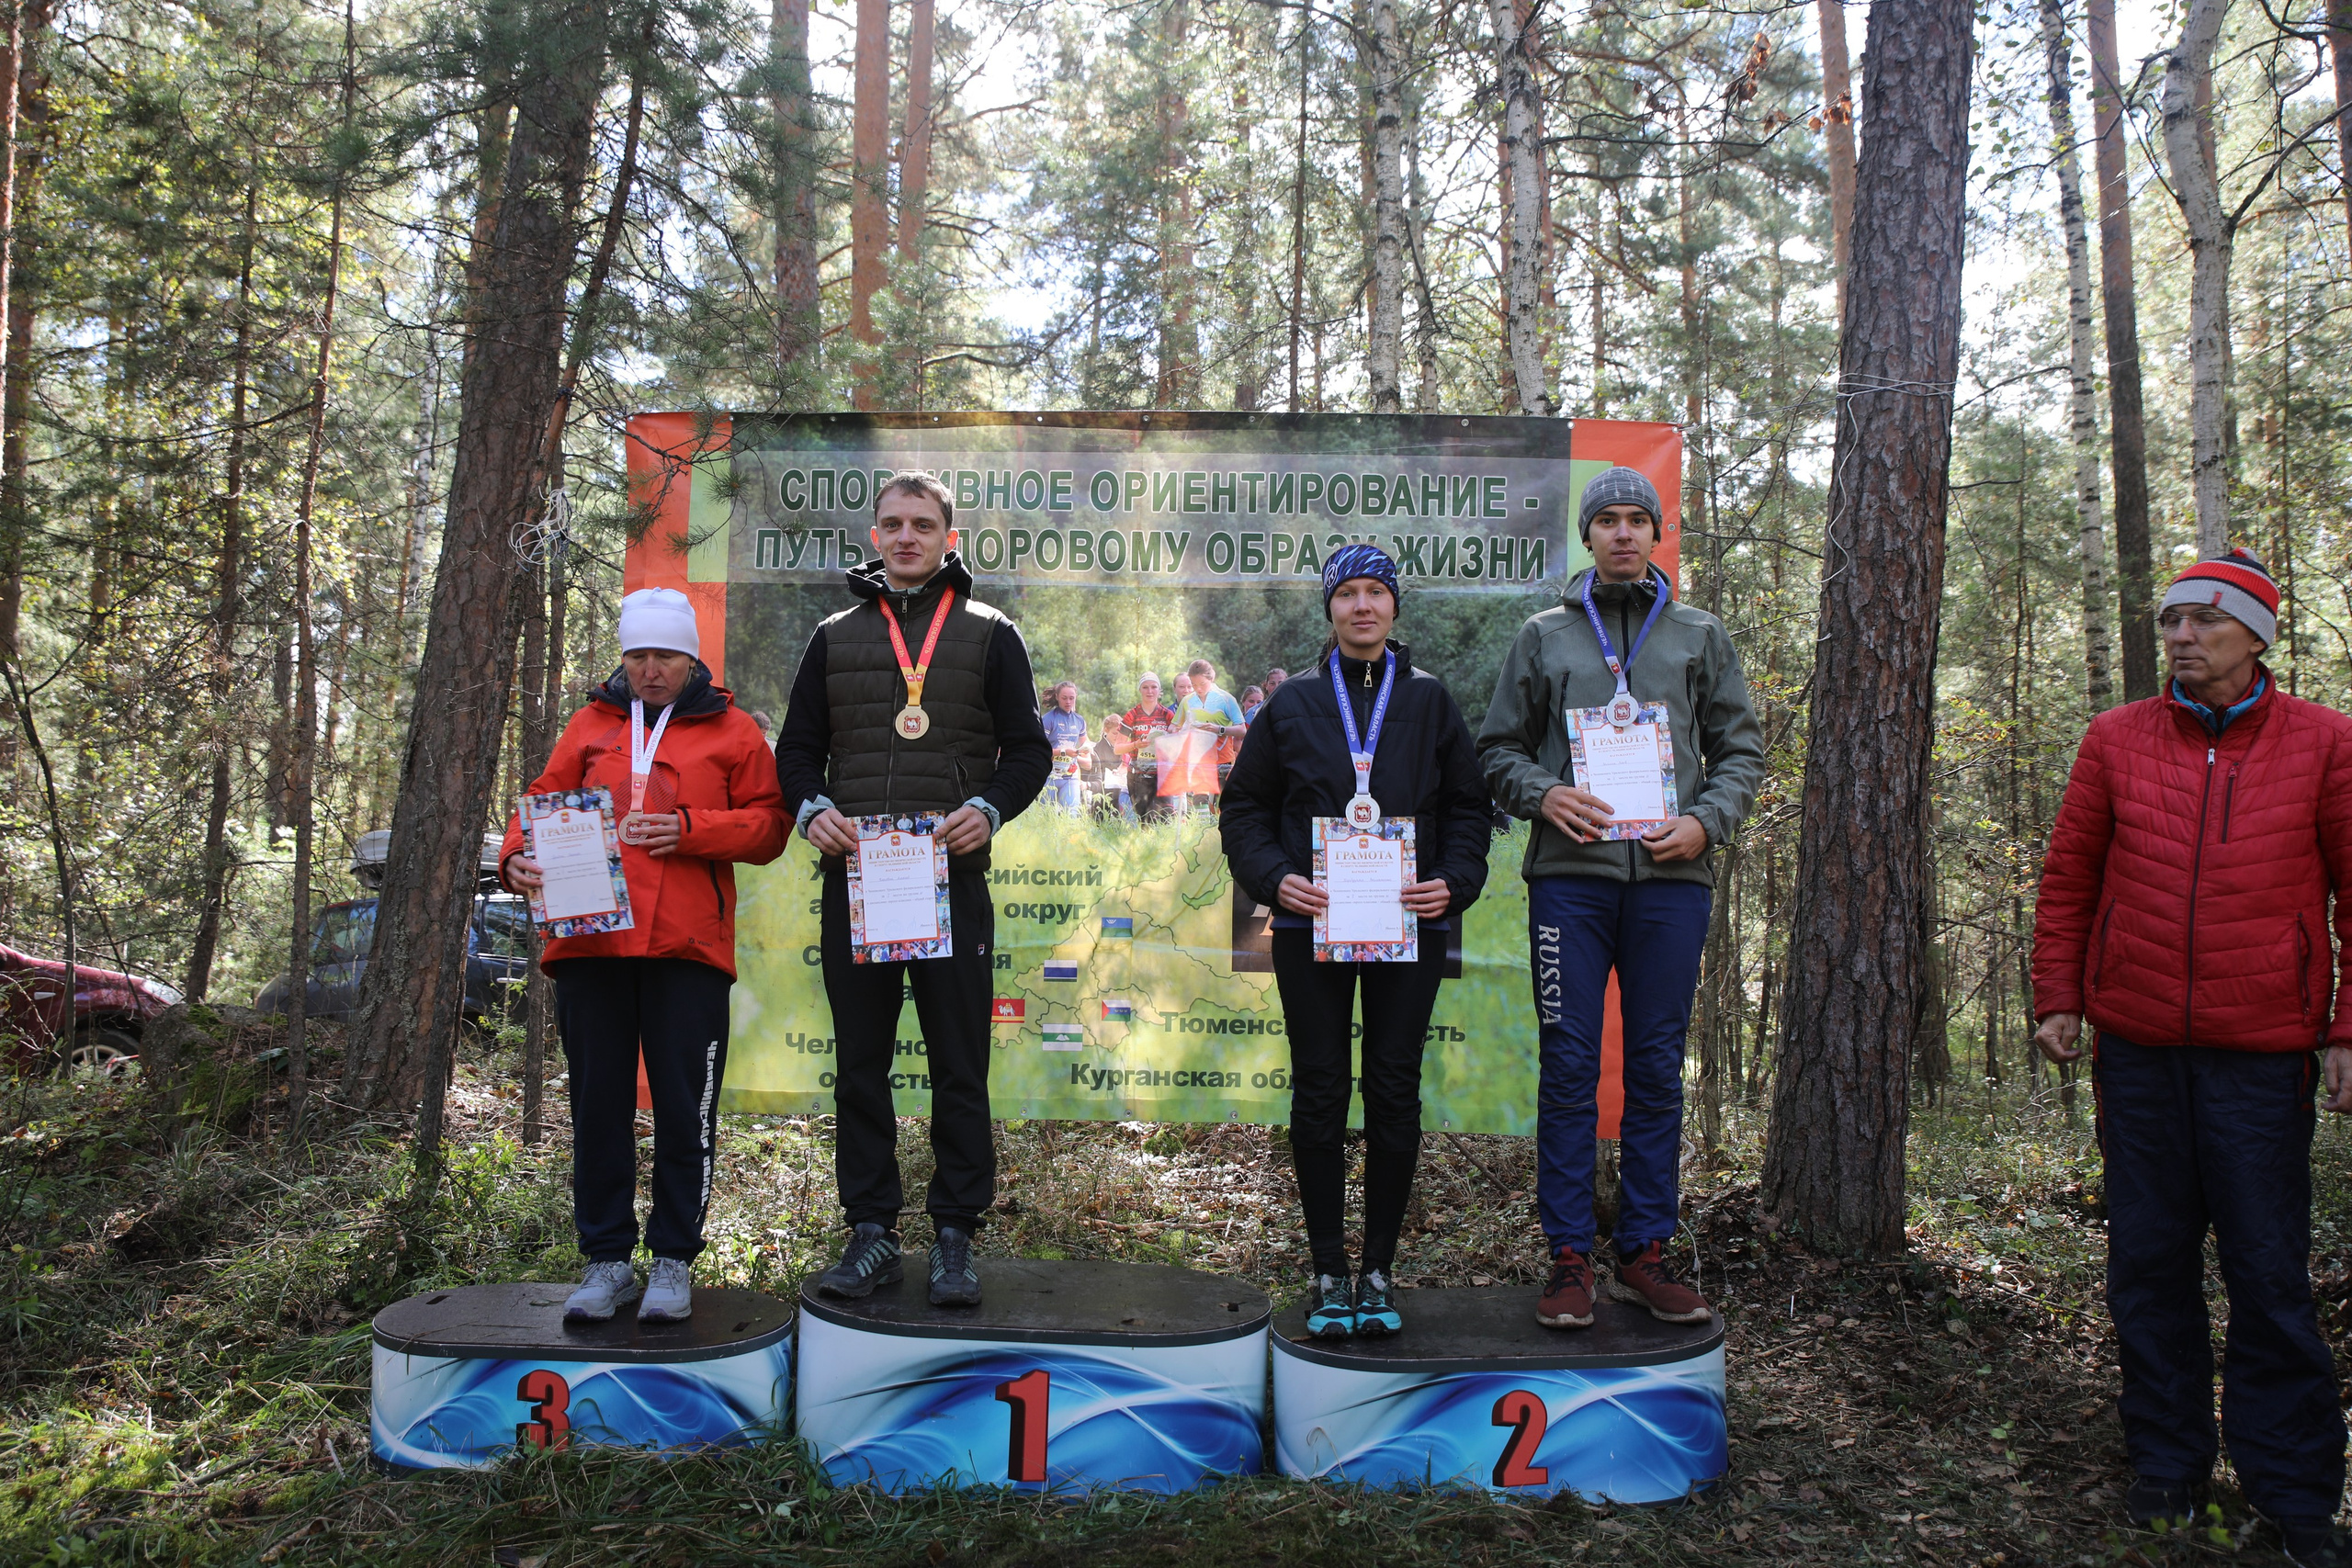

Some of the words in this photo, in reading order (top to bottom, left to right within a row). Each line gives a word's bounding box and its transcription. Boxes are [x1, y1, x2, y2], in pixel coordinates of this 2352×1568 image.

[1090, 470, 1508, 518] ОРИЕНТИРОВАНИЕ
[754, 528, 865, 570] ПУТЬ
[1205, 531, 1377, 576] ОБРА
[1392, 533, 1546, 581] ЖИЗНИ
[924, 626, 939, 654] ОБЛАСТЬ
[1585, 600, 1608, 647] ЧЕЛЯБИНСКАЯ
[1333, 663, 1345, 694] ОБЛАСТЬ
[1376, 664, 1393, 708] ЧЕЛЯБИНСКАЯ
[1340, 693, 1357, 742] ЧЕЛЯБИНСКАЯ
[1368, 707, 1383, 741] ОБЛАСТЬ
[1592, 734, 1649, 747] ГРАМОТА
[540, 823, 595, 838] ГРАМОТА
[868, 847, 926, 860] ГРАМОТА
[1335, 851, 1394, 861] ГРАМОТА
[1003, 902, 1086, 925] округ
[1538, 924, 1562, 1024] RUSSIA
[1159, 1011, 1289, 1036] Тюменс
[700, 1040, 718, 1148] ЧЕЛЯБИНСКАЯ
[1071, 1063, 1241, 1091] Курганская
[516, 1370, 571, 1451] 3
[995, 1370, 1051, 1483] 1
[1491, 1389, 1549, 1487] 2
